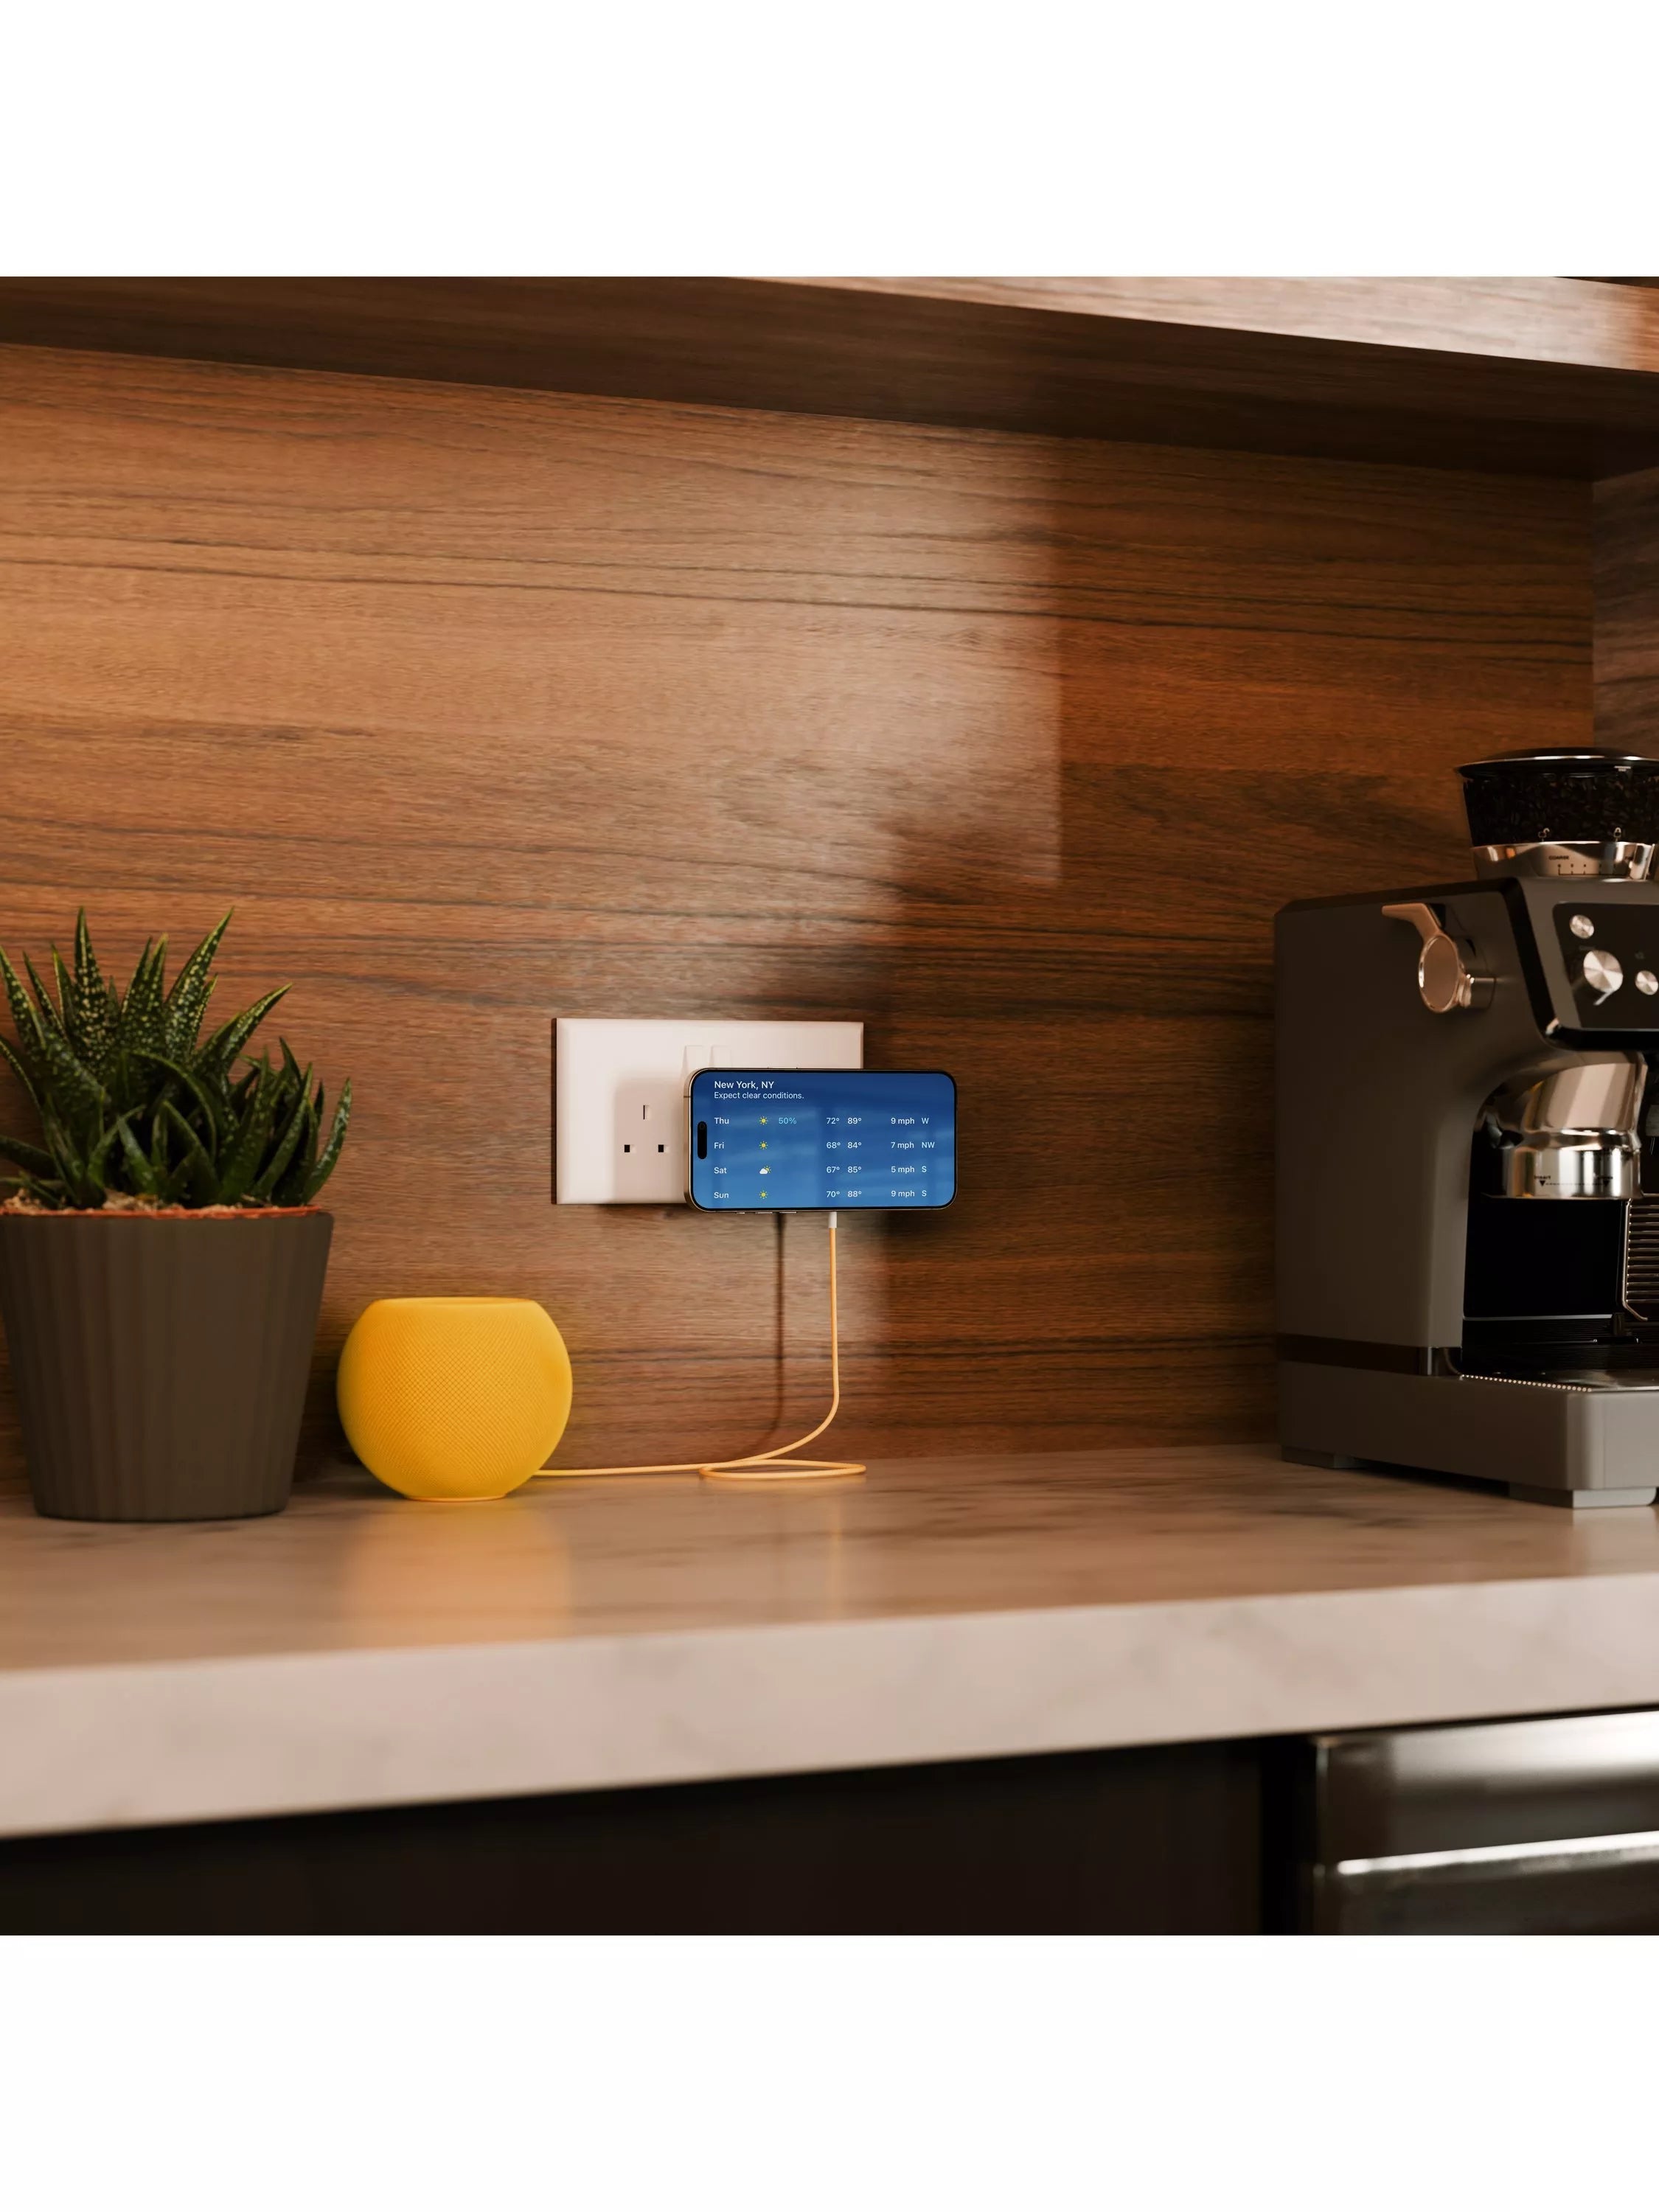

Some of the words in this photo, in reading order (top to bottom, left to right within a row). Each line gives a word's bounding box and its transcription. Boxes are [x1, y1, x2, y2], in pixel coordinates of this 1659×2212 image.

[714, 1080, 734, 1089] New
[736, 1080, 759, 1091] York,
[761, 1080, 774, 1089] NY
[714, 1091, 740, 1101] Expect
[742, 1091, 761, 1099] clear
[762, 1091, 804, 1099] conditions.
[714, 1116, 730, 1124] Thu
[897, 1117, 915, 1126] mph
[714, 1141, 725, 1150] Fri
[897, 1141, 915, 1150] mph
[714, 1166, 727, 1175] Sat
[826, 1166, 841, 1174] 67°
[847, 1166, 862, 1174] 85°
[891, 1165, 896, 1173] 5
[897, 1165, 915, 1175] mph
[921, 1165, 927, 1173] S
[826, 1190, 841, 1198] 70°
[847, 1190, 862, 1198] 88°
[891, 1189, 896, 1197] 9
[897, 1189, 915, 1199] mph
